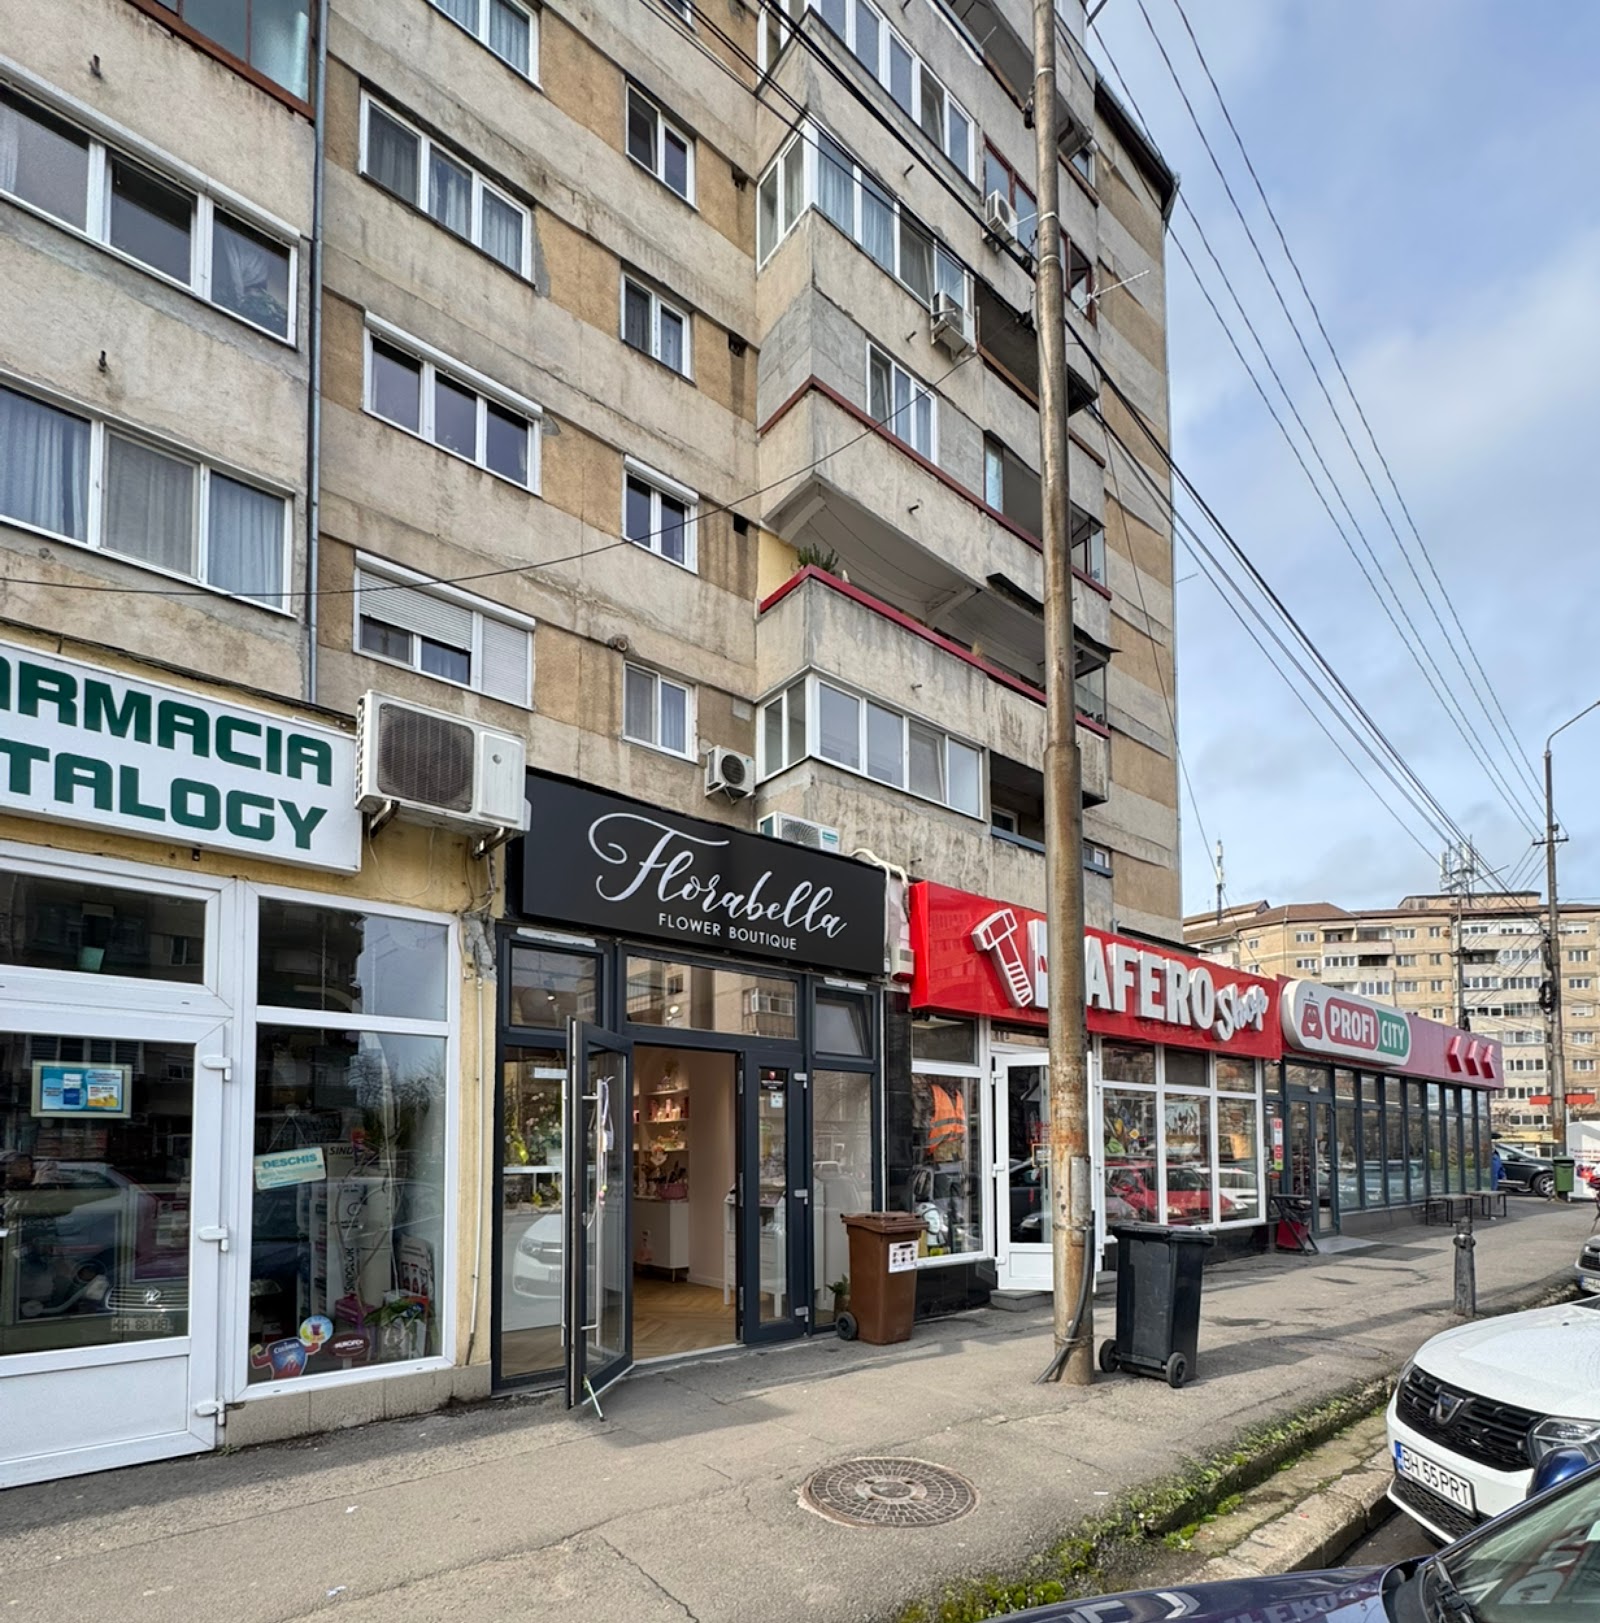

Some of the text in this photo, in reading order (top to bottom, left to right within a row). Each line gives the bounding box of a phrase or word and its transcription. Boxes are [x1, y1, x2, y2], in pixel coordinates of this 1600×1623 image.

[0, 655, 332, 787] RMACIA
[0, 737, 328, 850] TALOGY
[588, 811, 847, 939] Florabella
[659, 912, 797, 951] FLOWER BOUTIQUE
[1329, 1004, 1405, 1050] PROFI CITY
[262, 1153, 317, 1169] DESCHIS
[1402, 1448, 1420, 1477] BH
